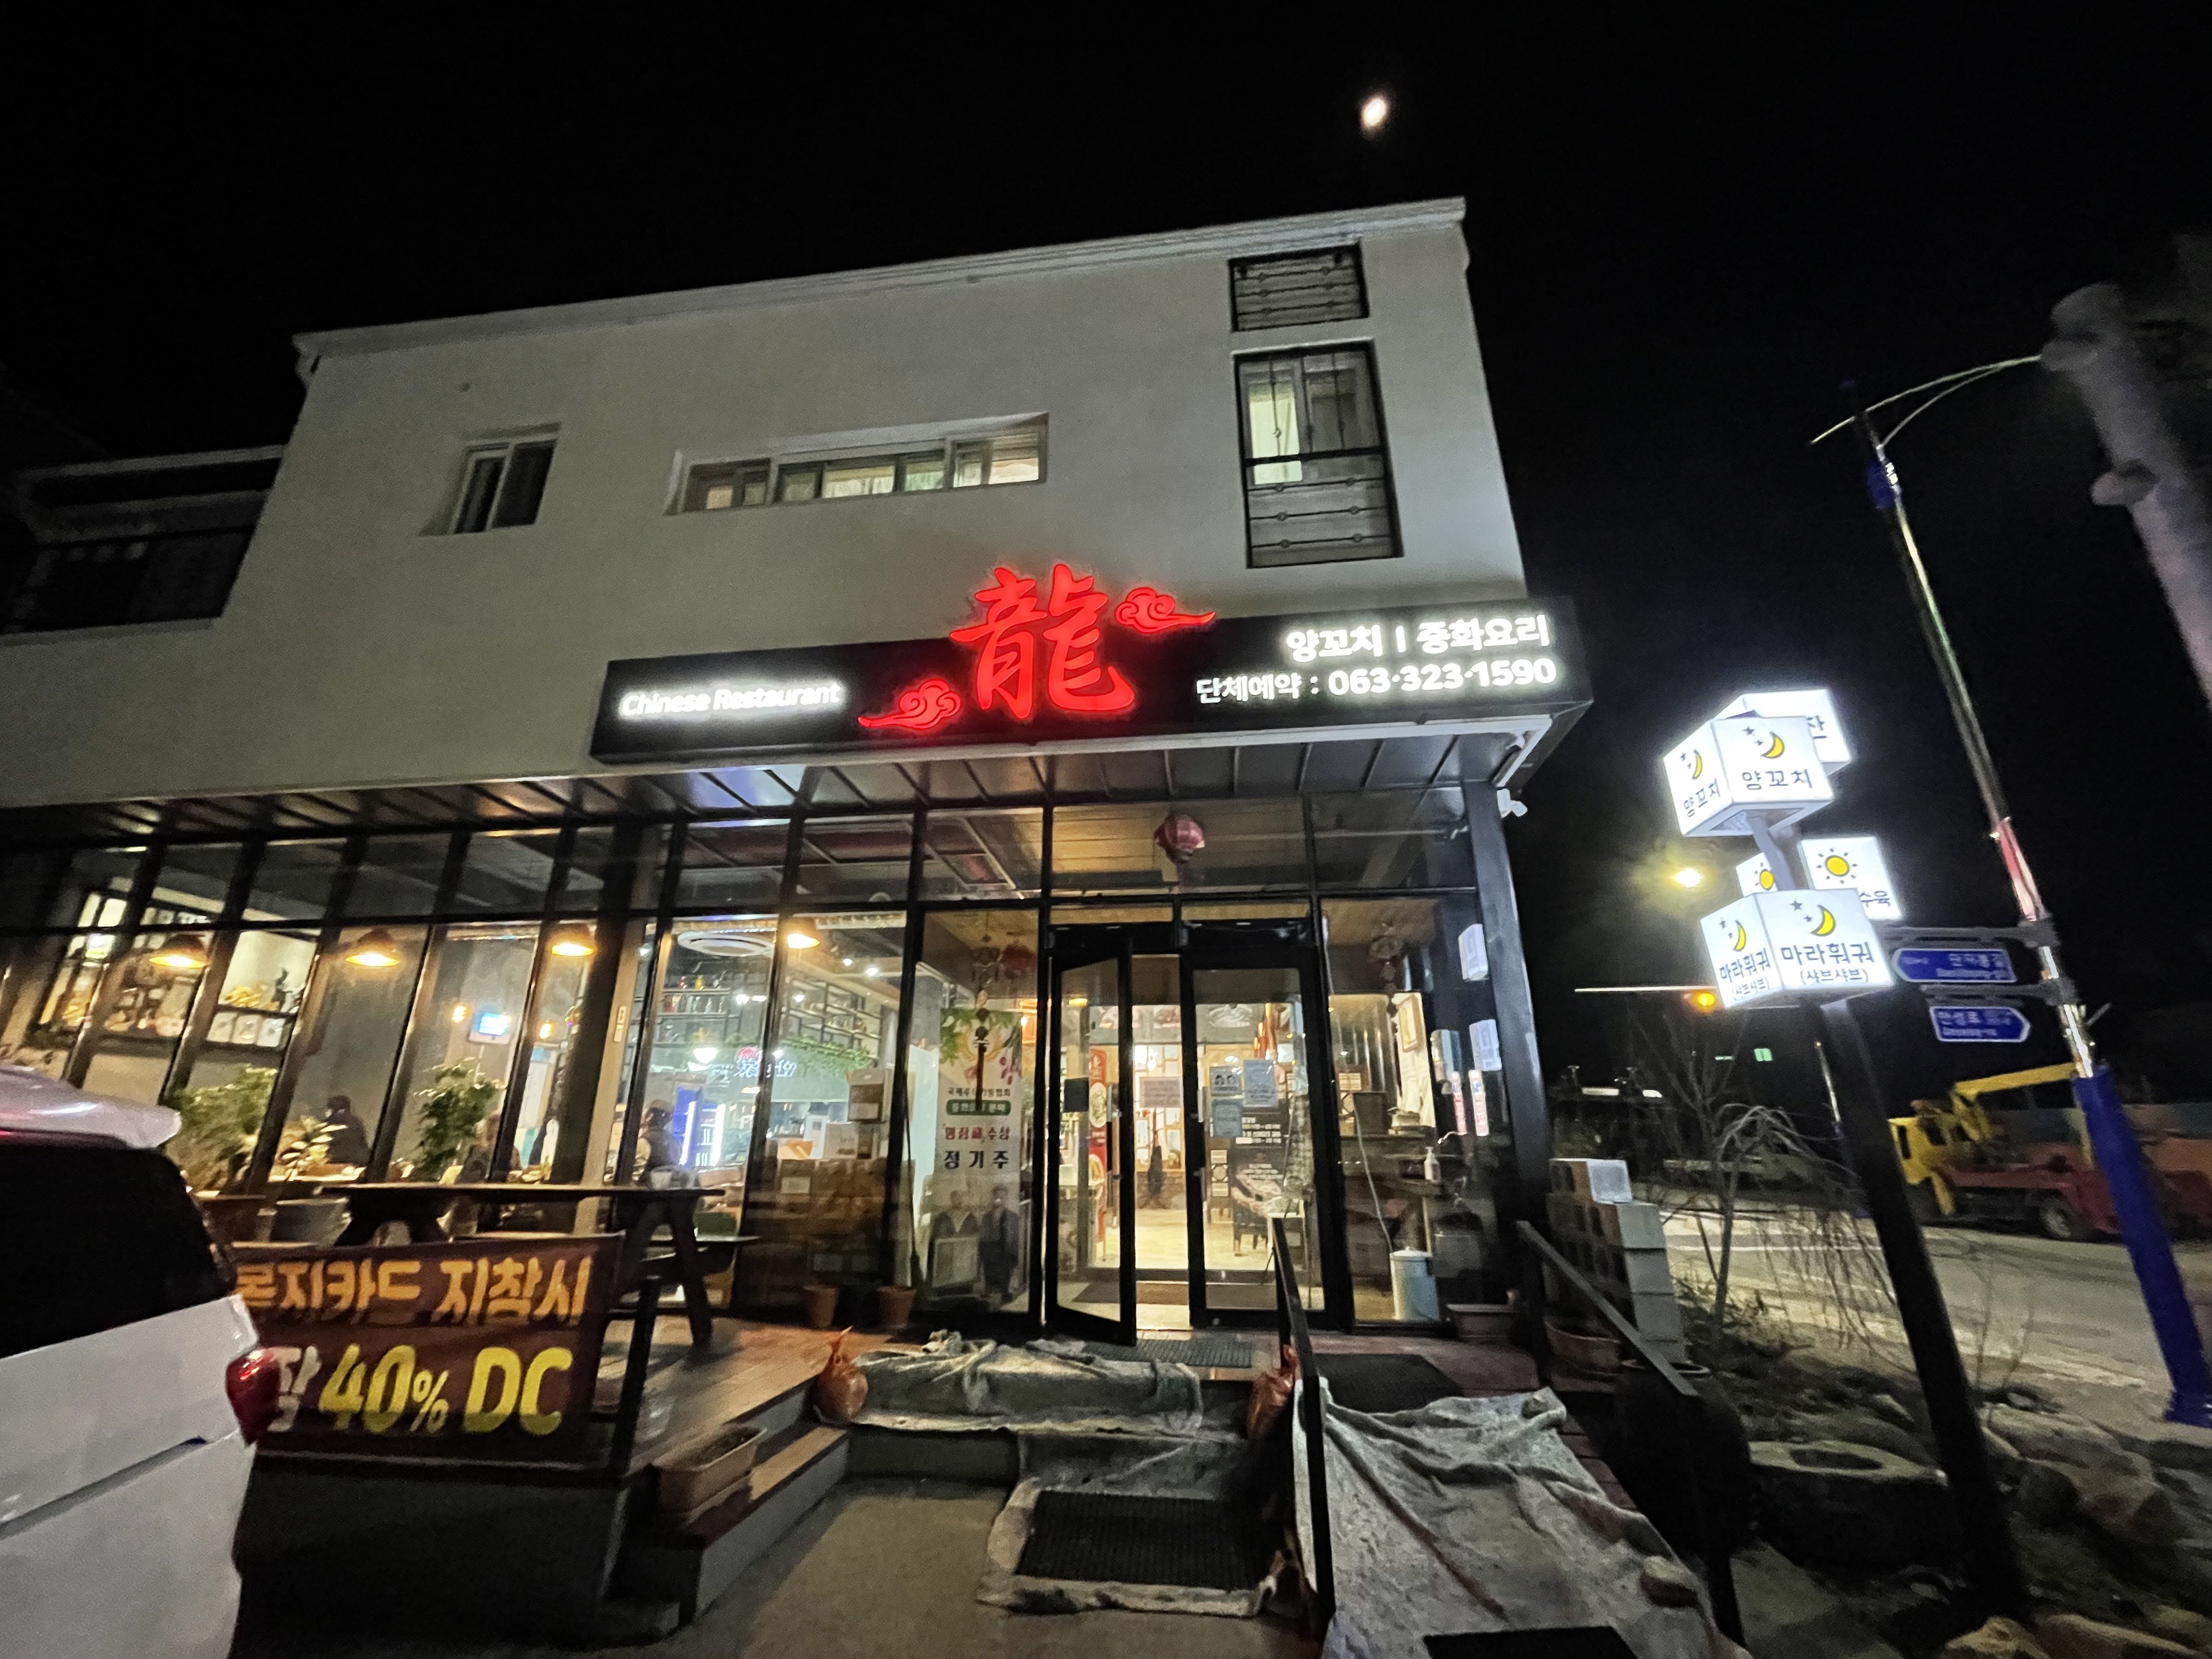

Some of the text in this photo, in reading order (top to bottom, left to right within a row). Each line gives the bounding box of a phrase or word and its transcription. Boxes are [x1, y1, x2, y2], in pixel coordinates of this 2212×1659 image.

[950, 563, 1136, 719] 龍
[1286, 624, 1383, 663] 양꼬치
[1417, 614, 1550, 654] 중화요리
[622, 683, 841, 716] Chinese Restaurant
[1197, 673, 1302, 704] 단체예약
[1742, 769, 1813, 790] 양꼬치
[1684, 778, 1720, 817] 양꼬치
[1719, 948, 1771, 983] 마라훠궈
[1781, 942, 1875, 965] 마라훠궈
[1800, 968, 1869, 985] (샤브샤브)
[431, 1256, 591, 1325] 지참시
[318, 1344, 449, 1433] 40%
[462, 1346, 573, 1436] DC
